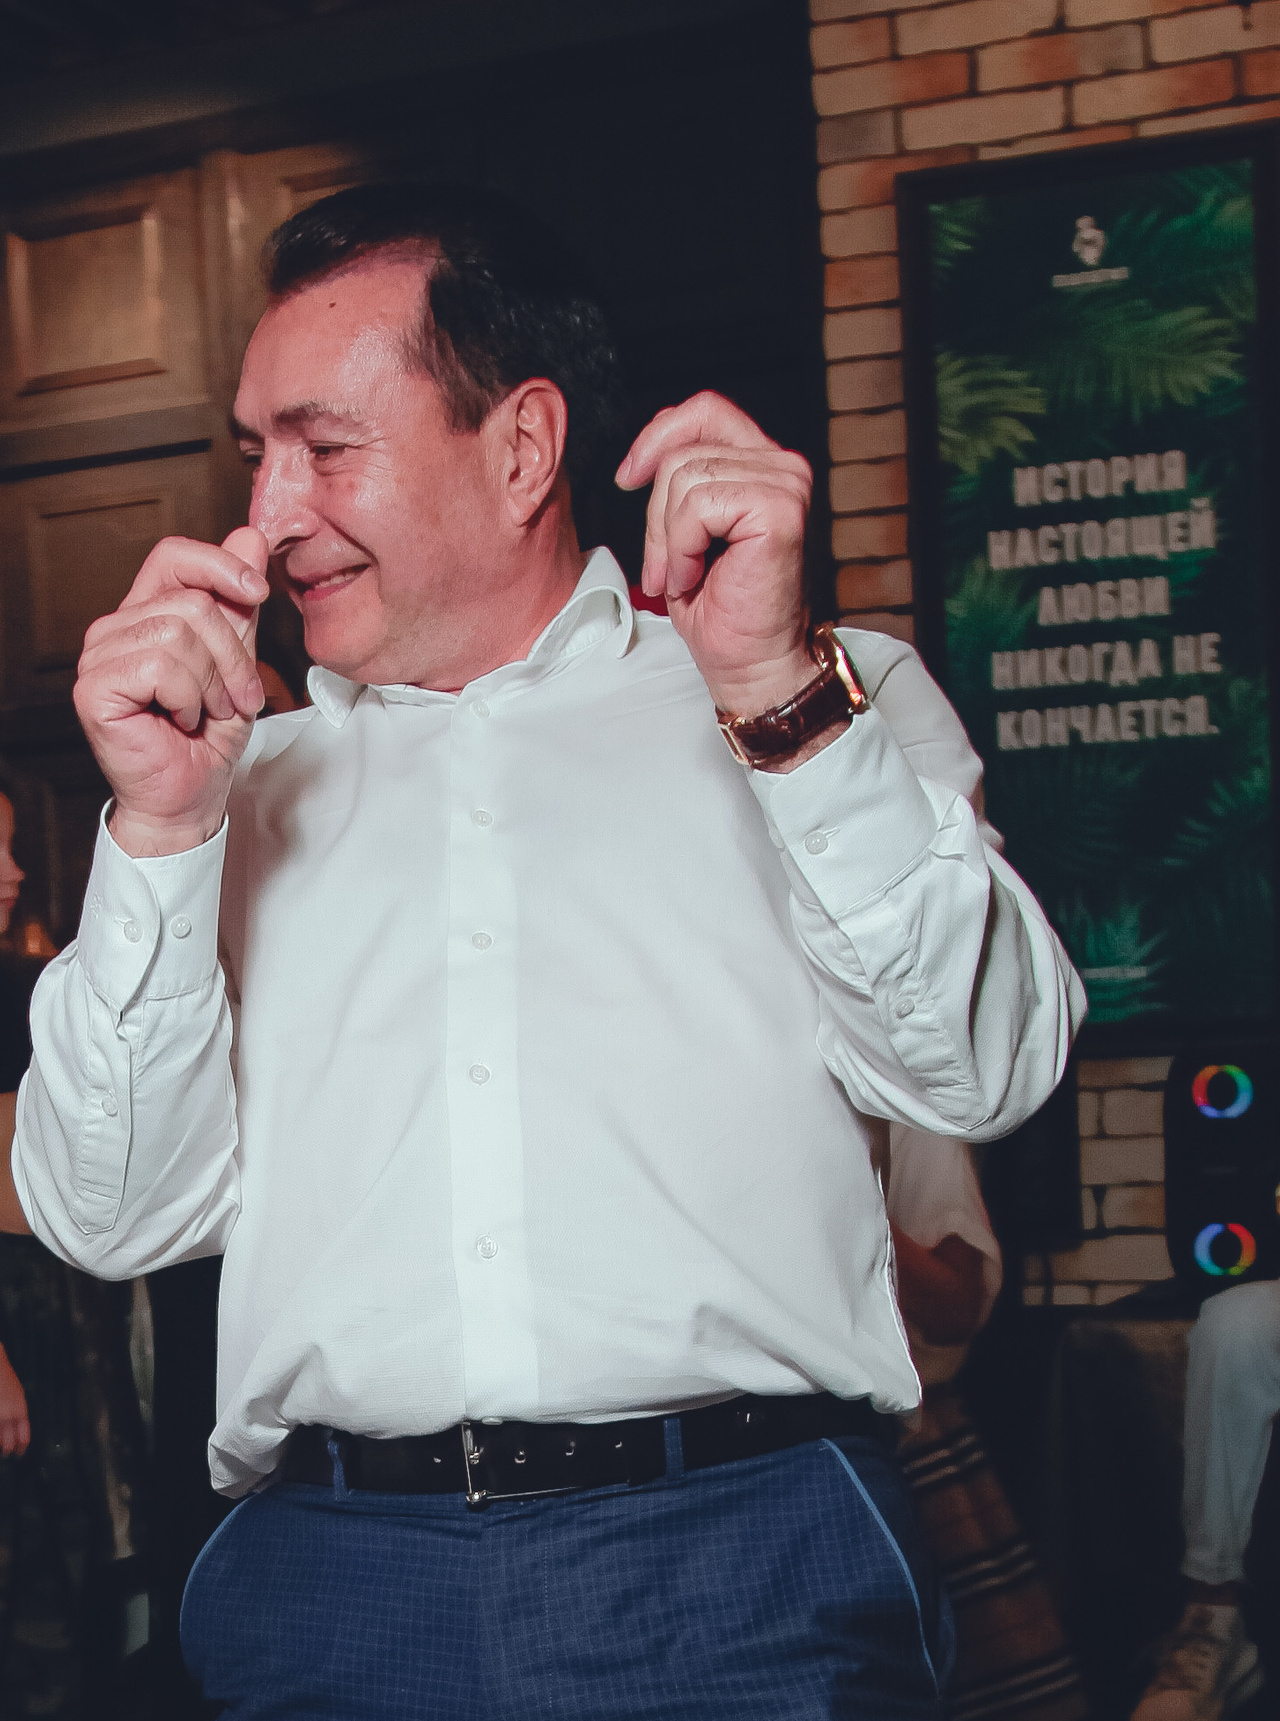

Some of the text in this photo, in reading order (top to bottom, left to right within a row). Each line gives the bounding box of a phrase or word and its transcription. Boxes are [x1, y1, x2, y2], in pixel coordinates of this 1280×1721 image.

[1014, 450, 1187, 506] ИСТОРИЯ
[988, 498, 1216, 569] НАСТОЯЩЕЙ
[1038, 576, 1170, 625] ЛЮБВИ
[992, 632, 1222, 690] НИКОГДА НЕ
[997, 695, 1220, 750] КОНЧАЕТСЯ.
